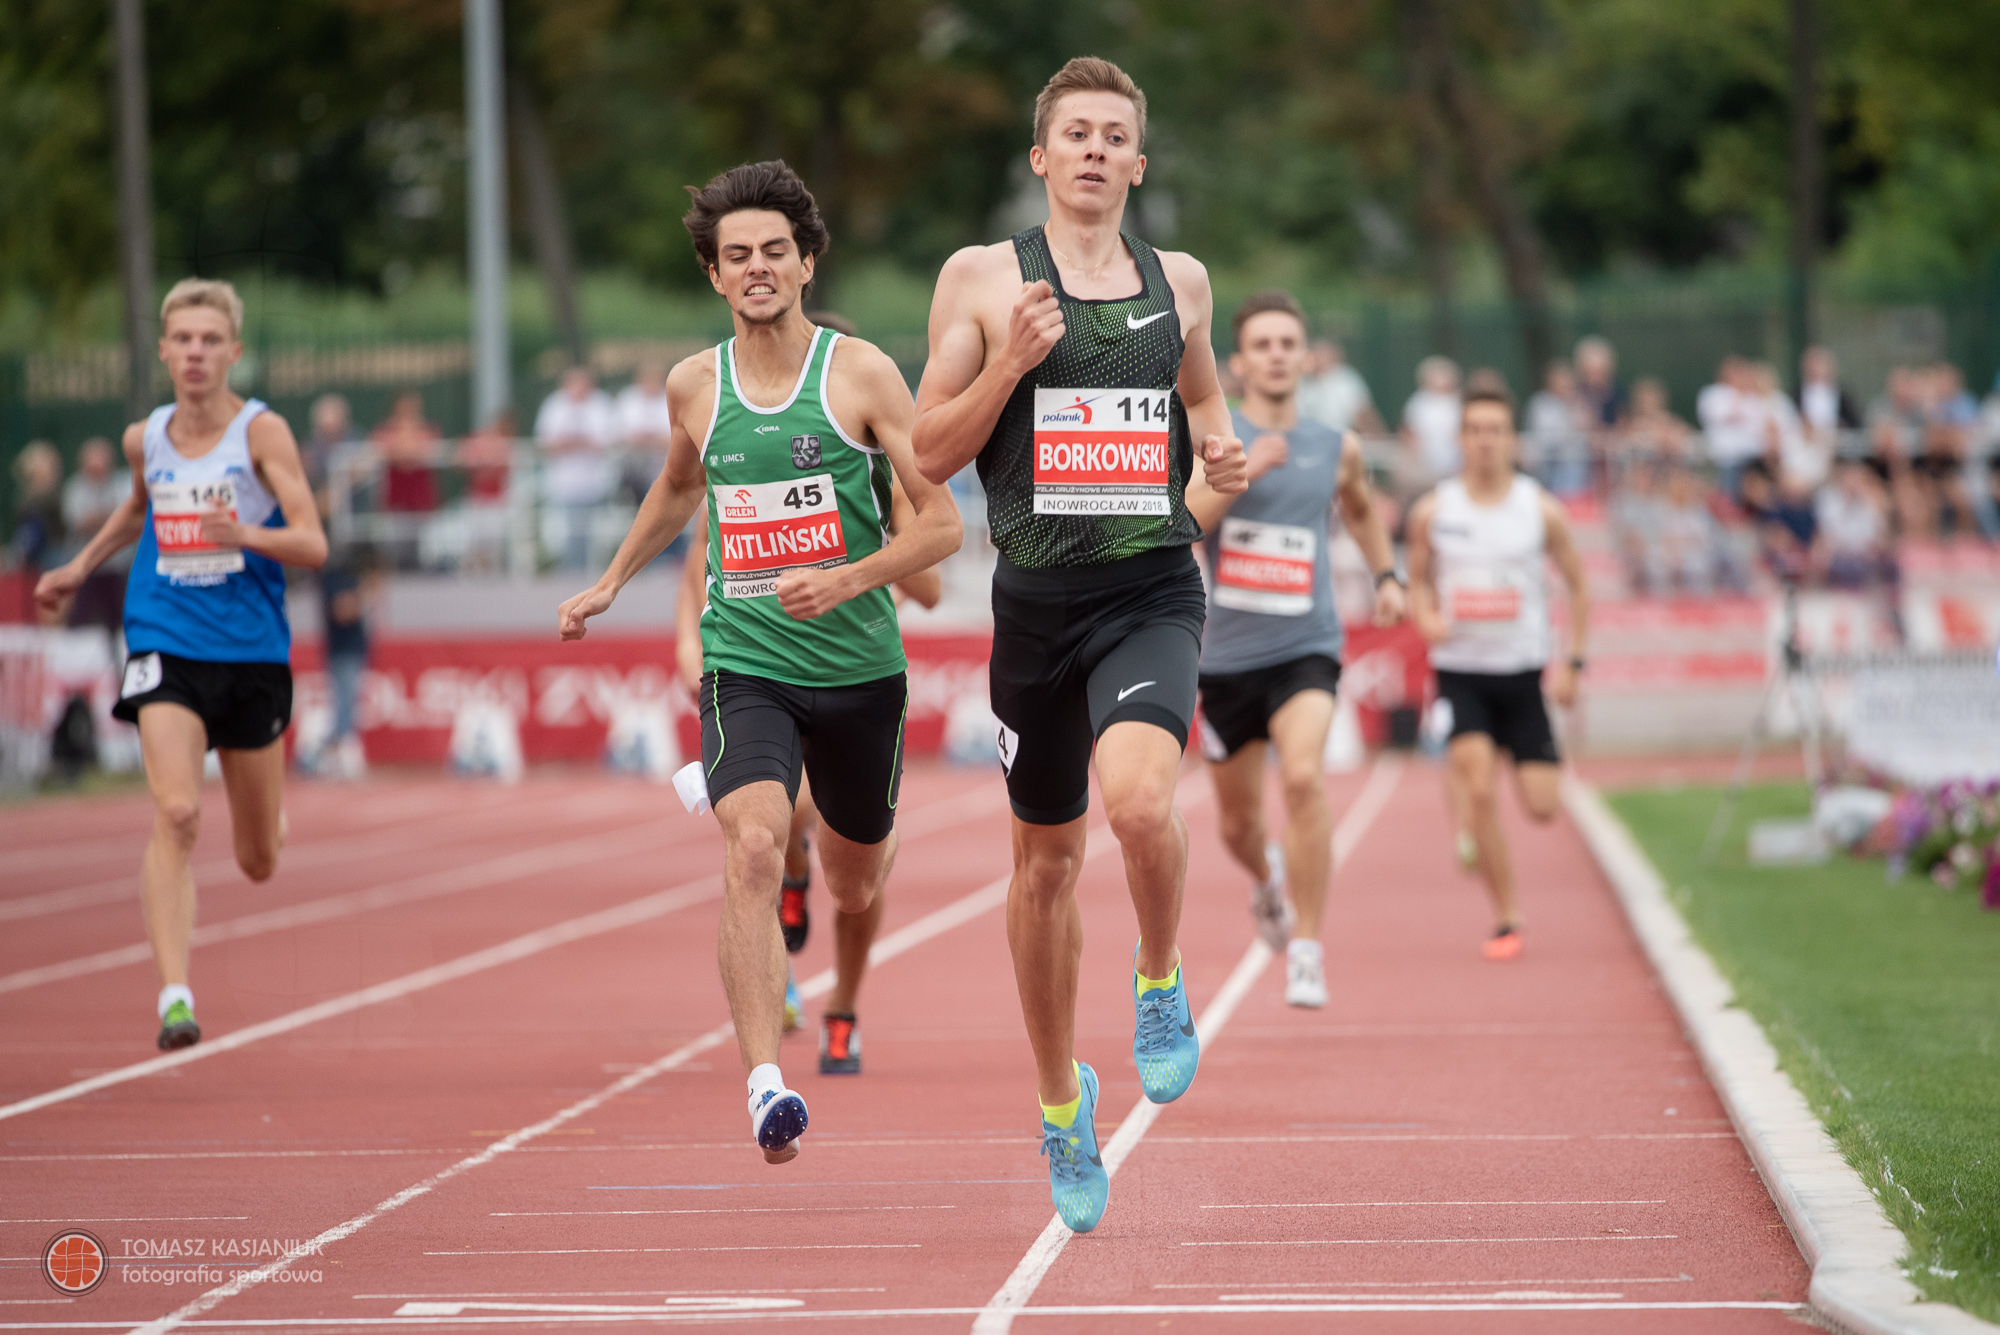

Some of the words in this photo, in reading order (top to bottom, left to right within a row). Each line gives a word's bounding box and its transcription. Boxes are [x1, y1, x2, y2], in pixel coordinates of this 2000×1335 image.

[1041, 412, 1082, 424] polanik
[1117, 396, 1167, 422] 114
[722, 453, 745, 464] UMCS
[1038, 442, 1166, 472] BORKOWSKI
[783, 483, 823, 510] 45
[1042, 499, 1139, 512] INOWROCŁAW
[1142, 500, 1163, 512] 2018
[726, 507, 755, 517] ORLEN
[722, 522, 840, 560] KITLIŃSKI
[730, 581, 777, 596] INOWRO
[997, 725, 1009, 761] 4
